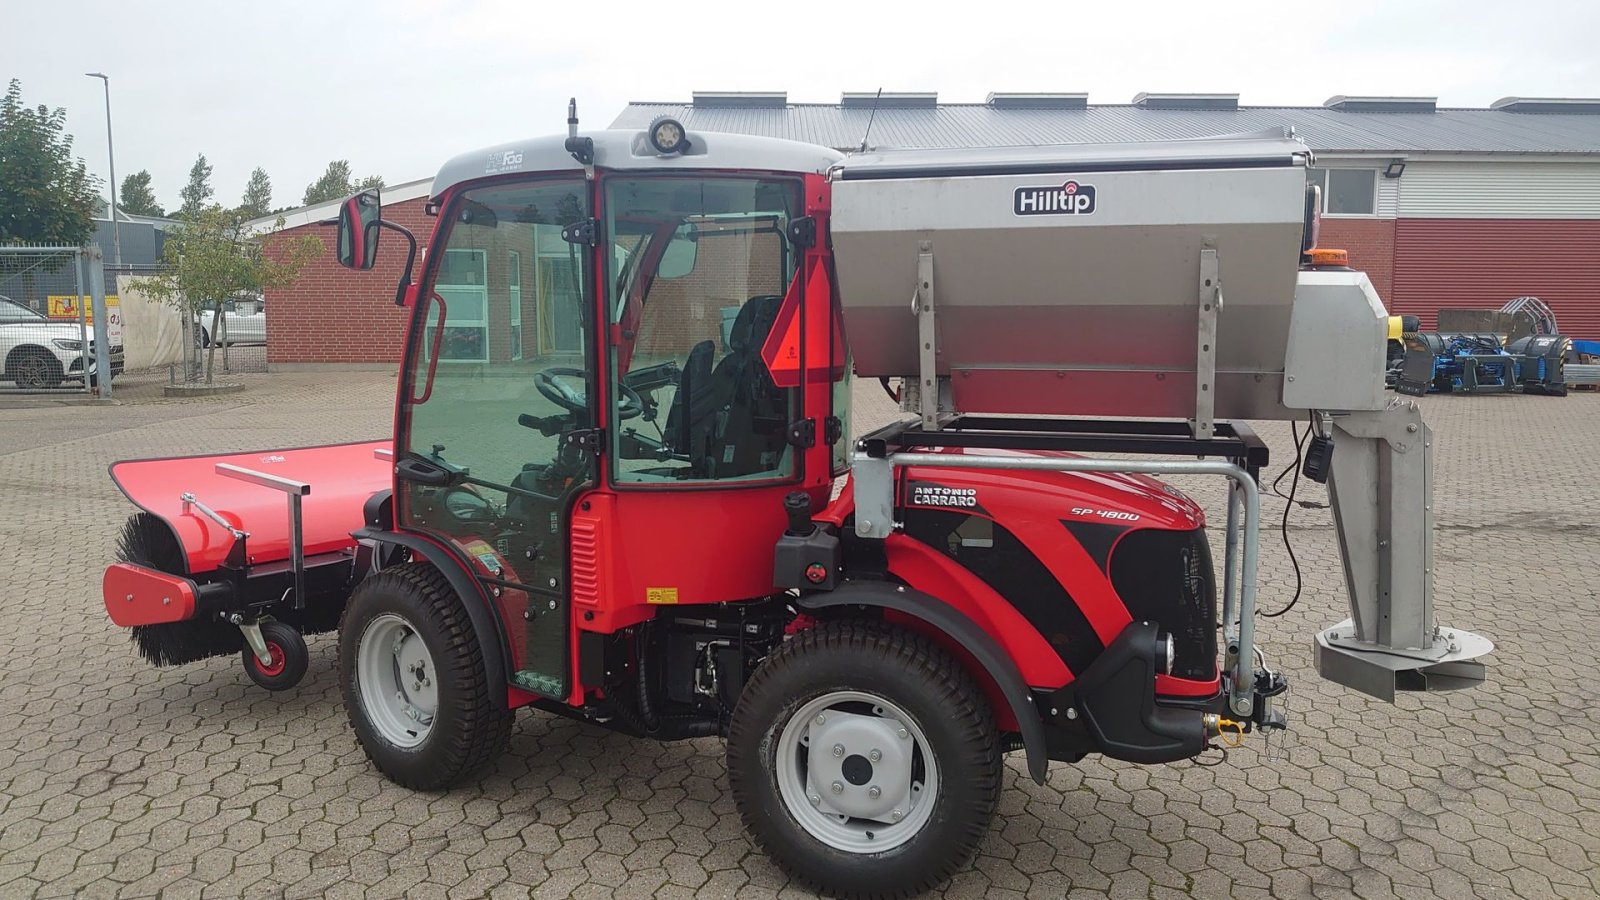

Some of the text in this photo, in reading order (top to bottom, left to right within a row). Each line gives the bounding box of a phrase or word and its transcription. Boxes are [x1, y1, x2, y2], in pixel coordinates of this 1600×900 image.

[1020, 190, 1091, 215] Hilltip
[914, 487, 977, 496] ANTONIO
[913, 494, 977, 507] CARRARO
[1071, 507, 1093, 516] SP
